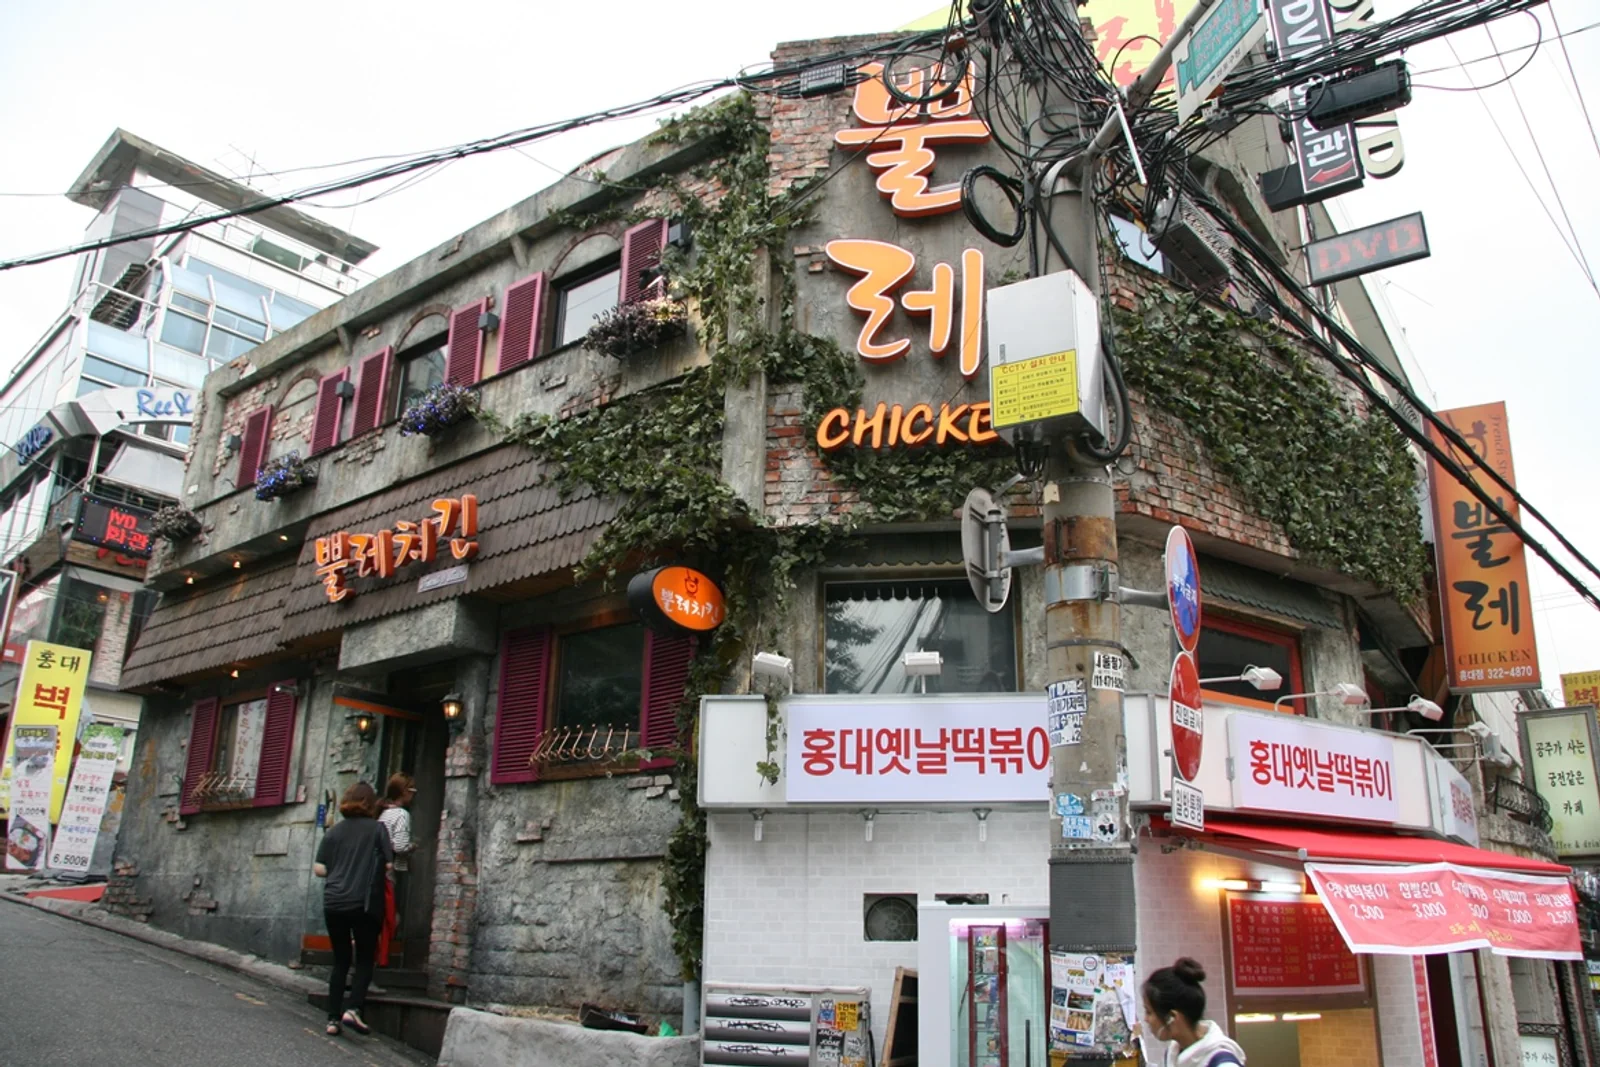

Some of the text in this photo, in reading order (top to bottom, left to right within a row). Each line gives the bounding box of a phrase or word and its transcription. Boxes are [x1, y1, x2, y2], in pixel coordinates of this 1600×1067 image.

[1318, 223, 1421, 273] DVD
[1001, 363, 1027, 375] CCTV
[315, 494, 479, 602] 뿔레치킨
[1451, 496, 1520, 635] 뿔레
[36, 650, 81, 674] 홍대
[1458, 649, 1532, 667] CHICKEN
[1487, 665, 1533, 680] 322-4870
[1535, 739, 1586, 758] 공주가 사는
[1249, 739, 1393, 802] 홍대옛날떡볶이
[1547, 770, 1585, 788] 궁전같은
[1563, 800, 1584, 817] 카페
[1349, 903, 1385, 920] 2,500
[1412, 901, 1447, 919] 3,000
[1504, 908, 1533, 924] 7,000
